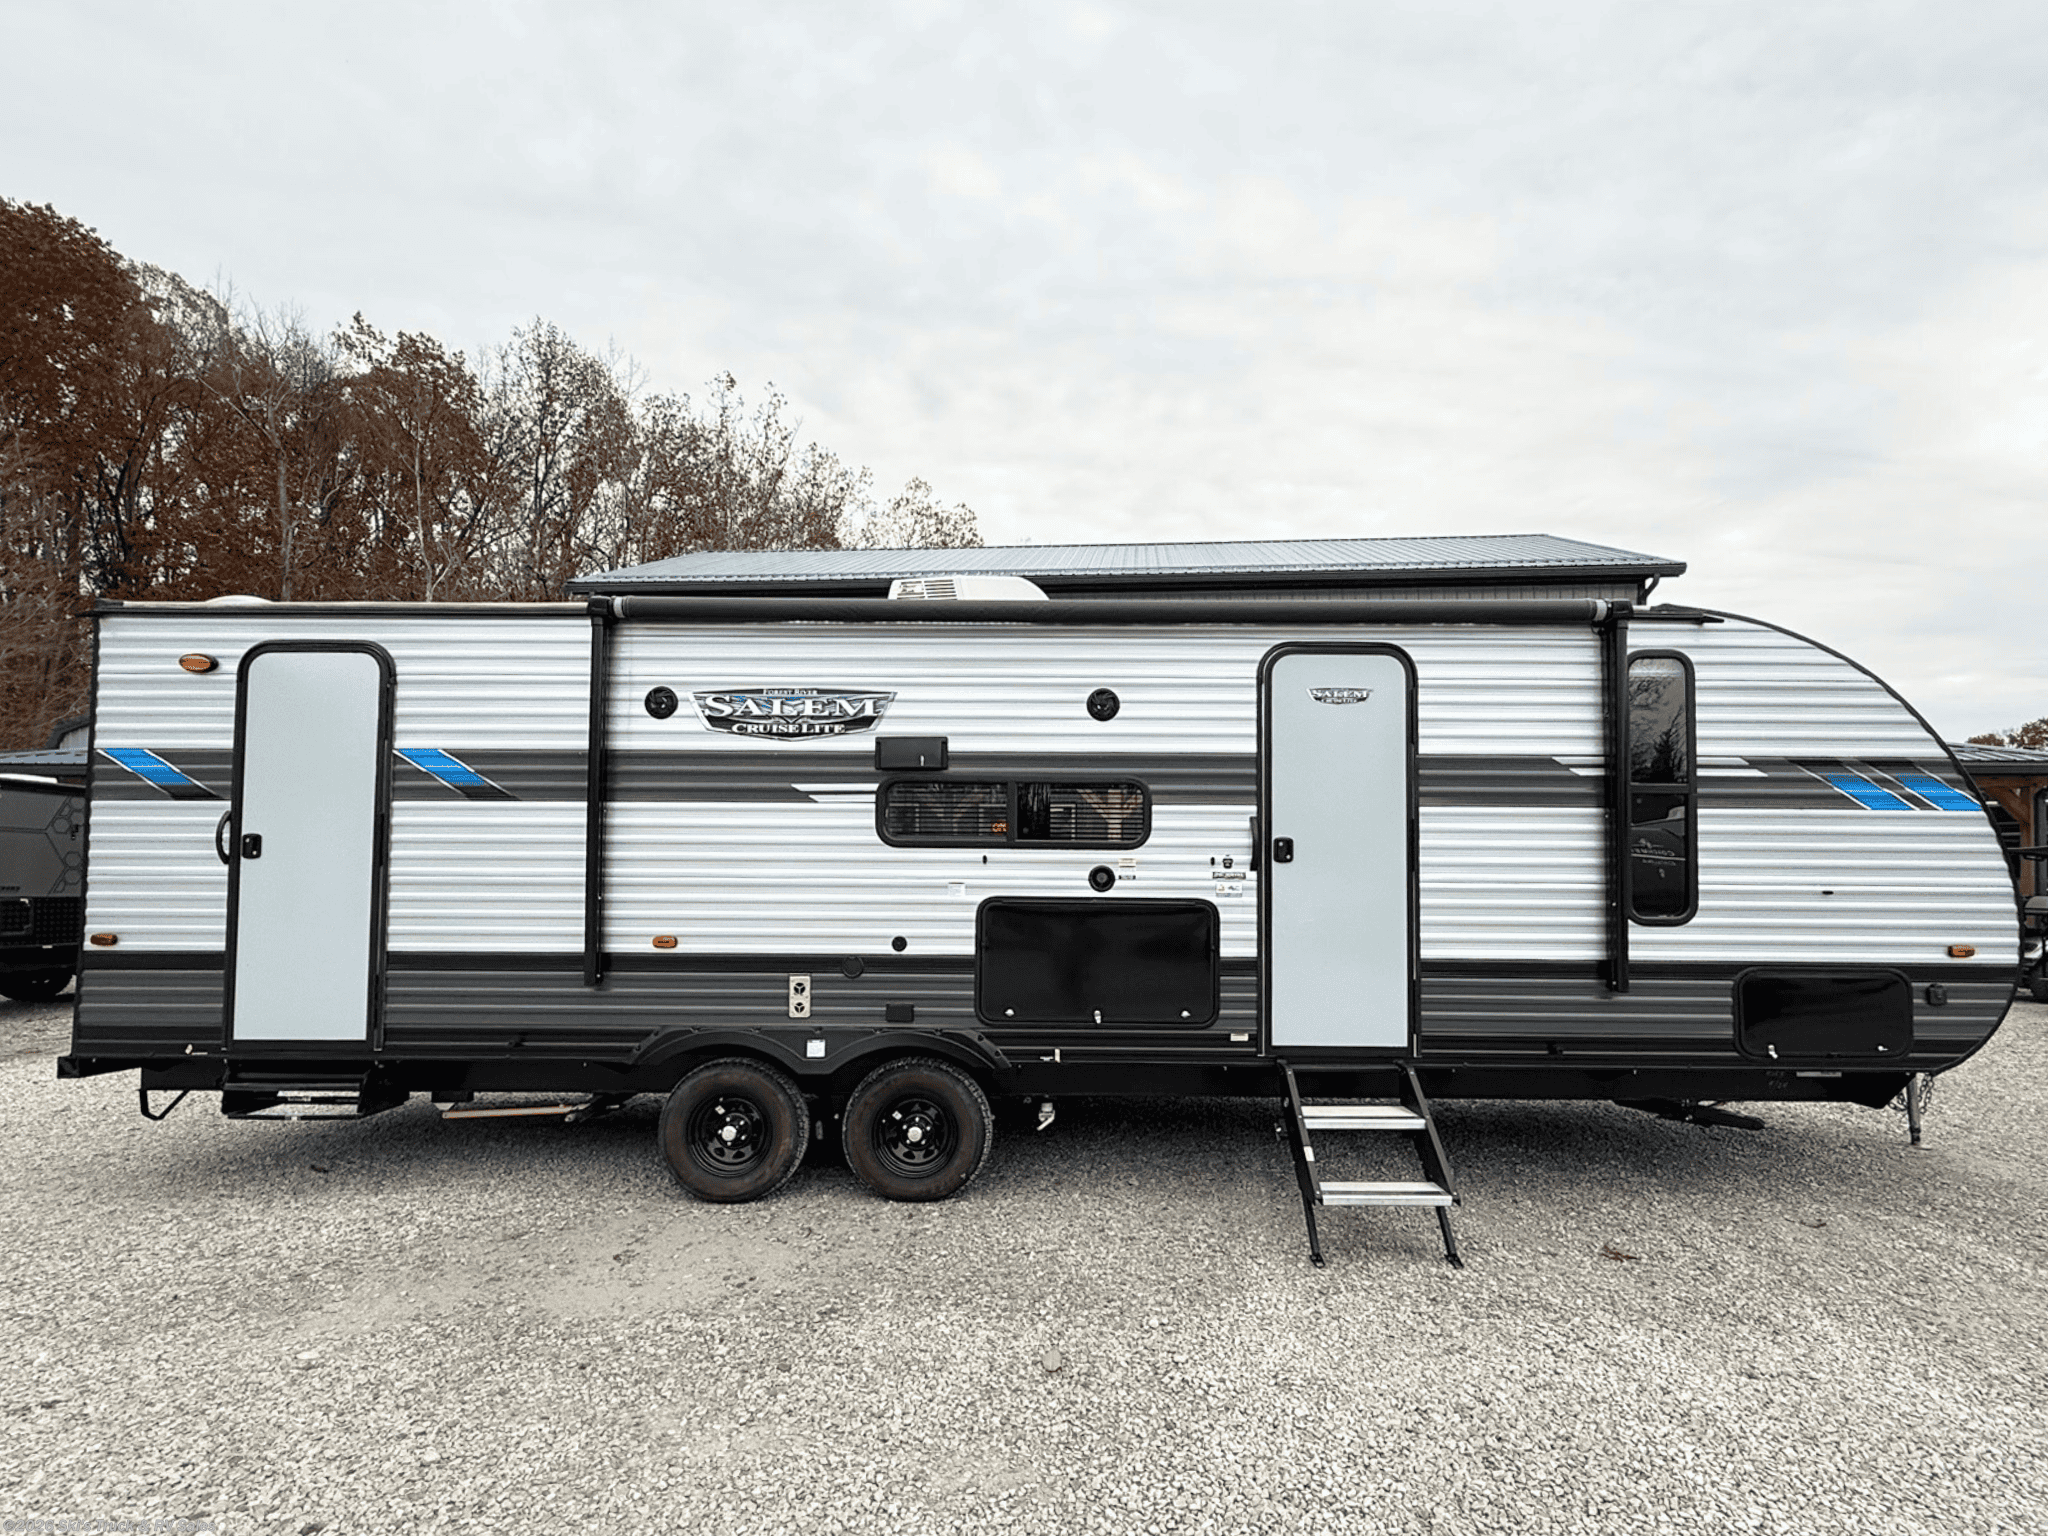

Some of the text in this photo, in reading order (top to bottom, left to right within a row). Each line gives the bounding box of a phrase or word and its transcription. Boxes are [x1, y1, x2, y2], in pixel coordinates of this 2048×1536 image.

[704, 694, 884, 717] SALEM
[731, 723, 846, 734] CRUISE LITE
